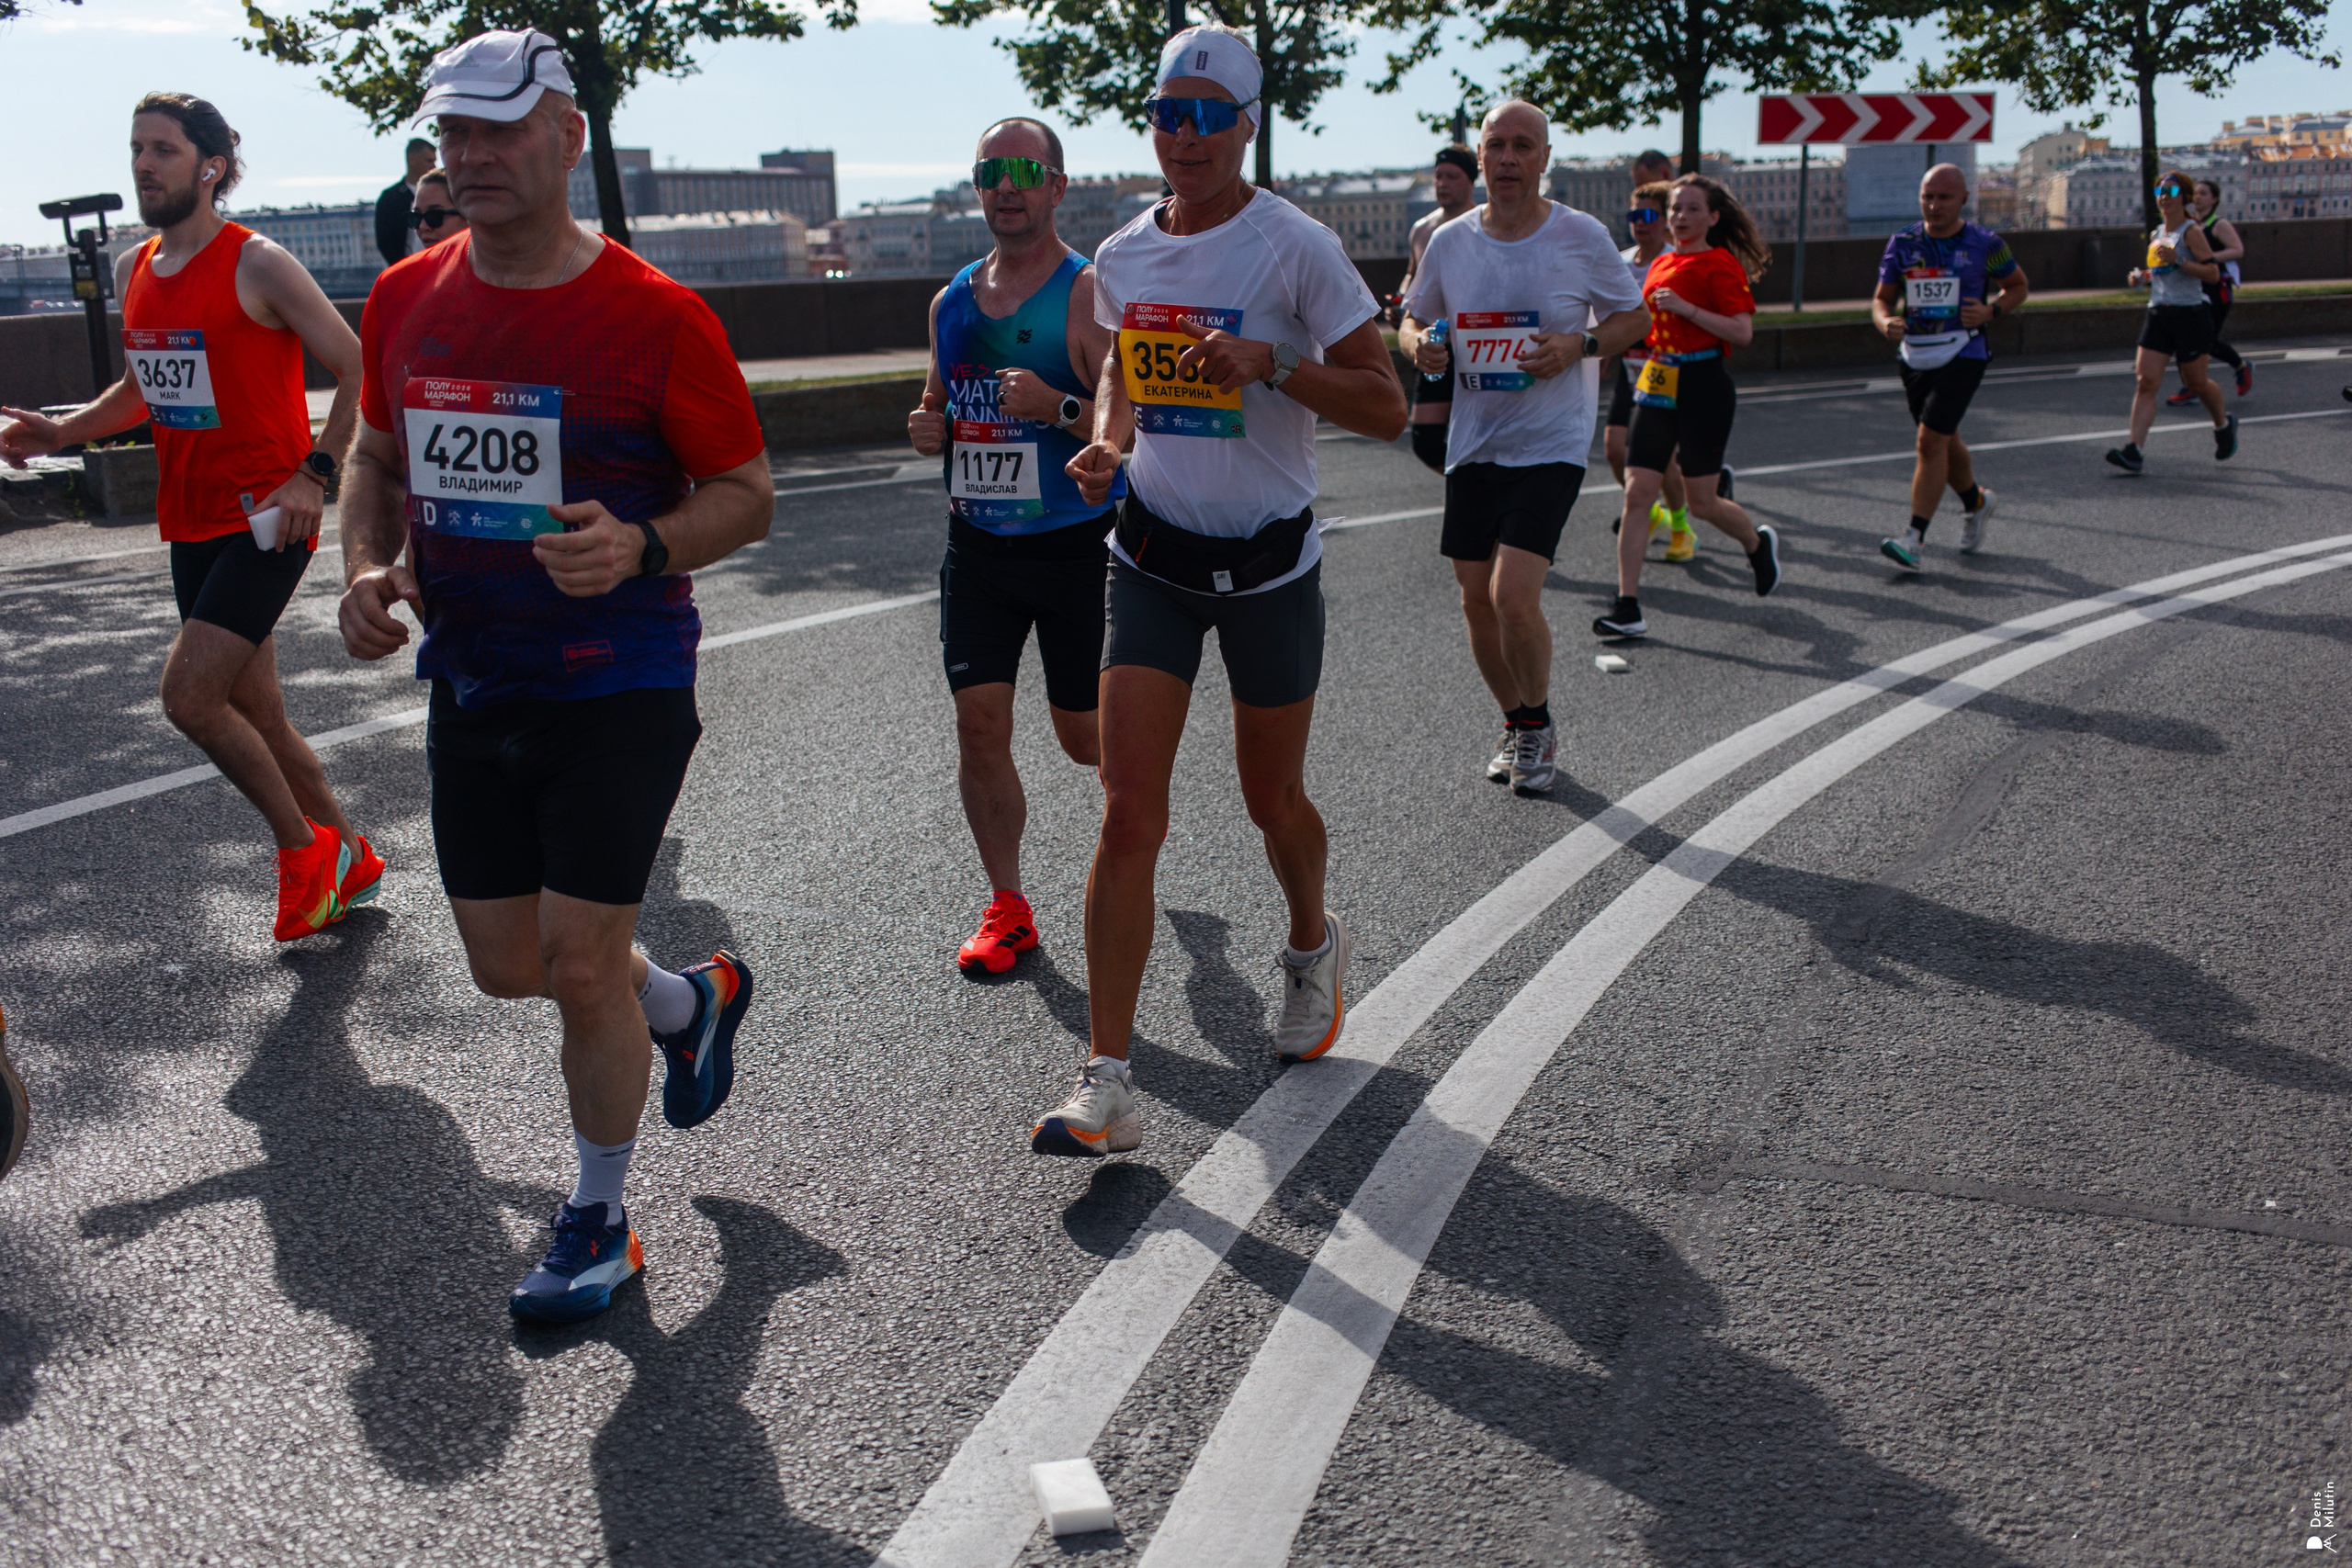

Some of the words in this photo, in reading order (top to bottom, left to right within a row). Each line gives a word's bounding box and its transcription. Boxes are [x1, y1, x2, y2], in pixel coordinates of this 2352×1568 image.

[1915, 282, 1952, 299] 1537
[1135, 313, 1169, 322] МАРАФОН
[167, 336, 180, 344] 21,1
[138, 358, 196, 389] 3637
[951, 363, 990, 381] YES
[425, 381, 451, 390] ПОЛУ
[1469, 376, 1477, 389] E
[159, 391, 181, 400] MARK
[424, 390, 470, 402] МАРАФОН
[492, 392, 514, 406] 21,1
[518, 394, 539, 407] КМ
[1144, 385, 1213, 400] ЕКАТЕРИНА
[991, 429, 1006, 437] 21,1
[424, 424, 539, 476] 4208
[960, 450, 1023, 481] 1177
[439, 476, 523, 493] ВЛАДИМИР
[966, 483, 1018, 495] ВЛАДИСЛАВ
[423, 501, 437, 525] D
[959, 501, 968, 516] E
